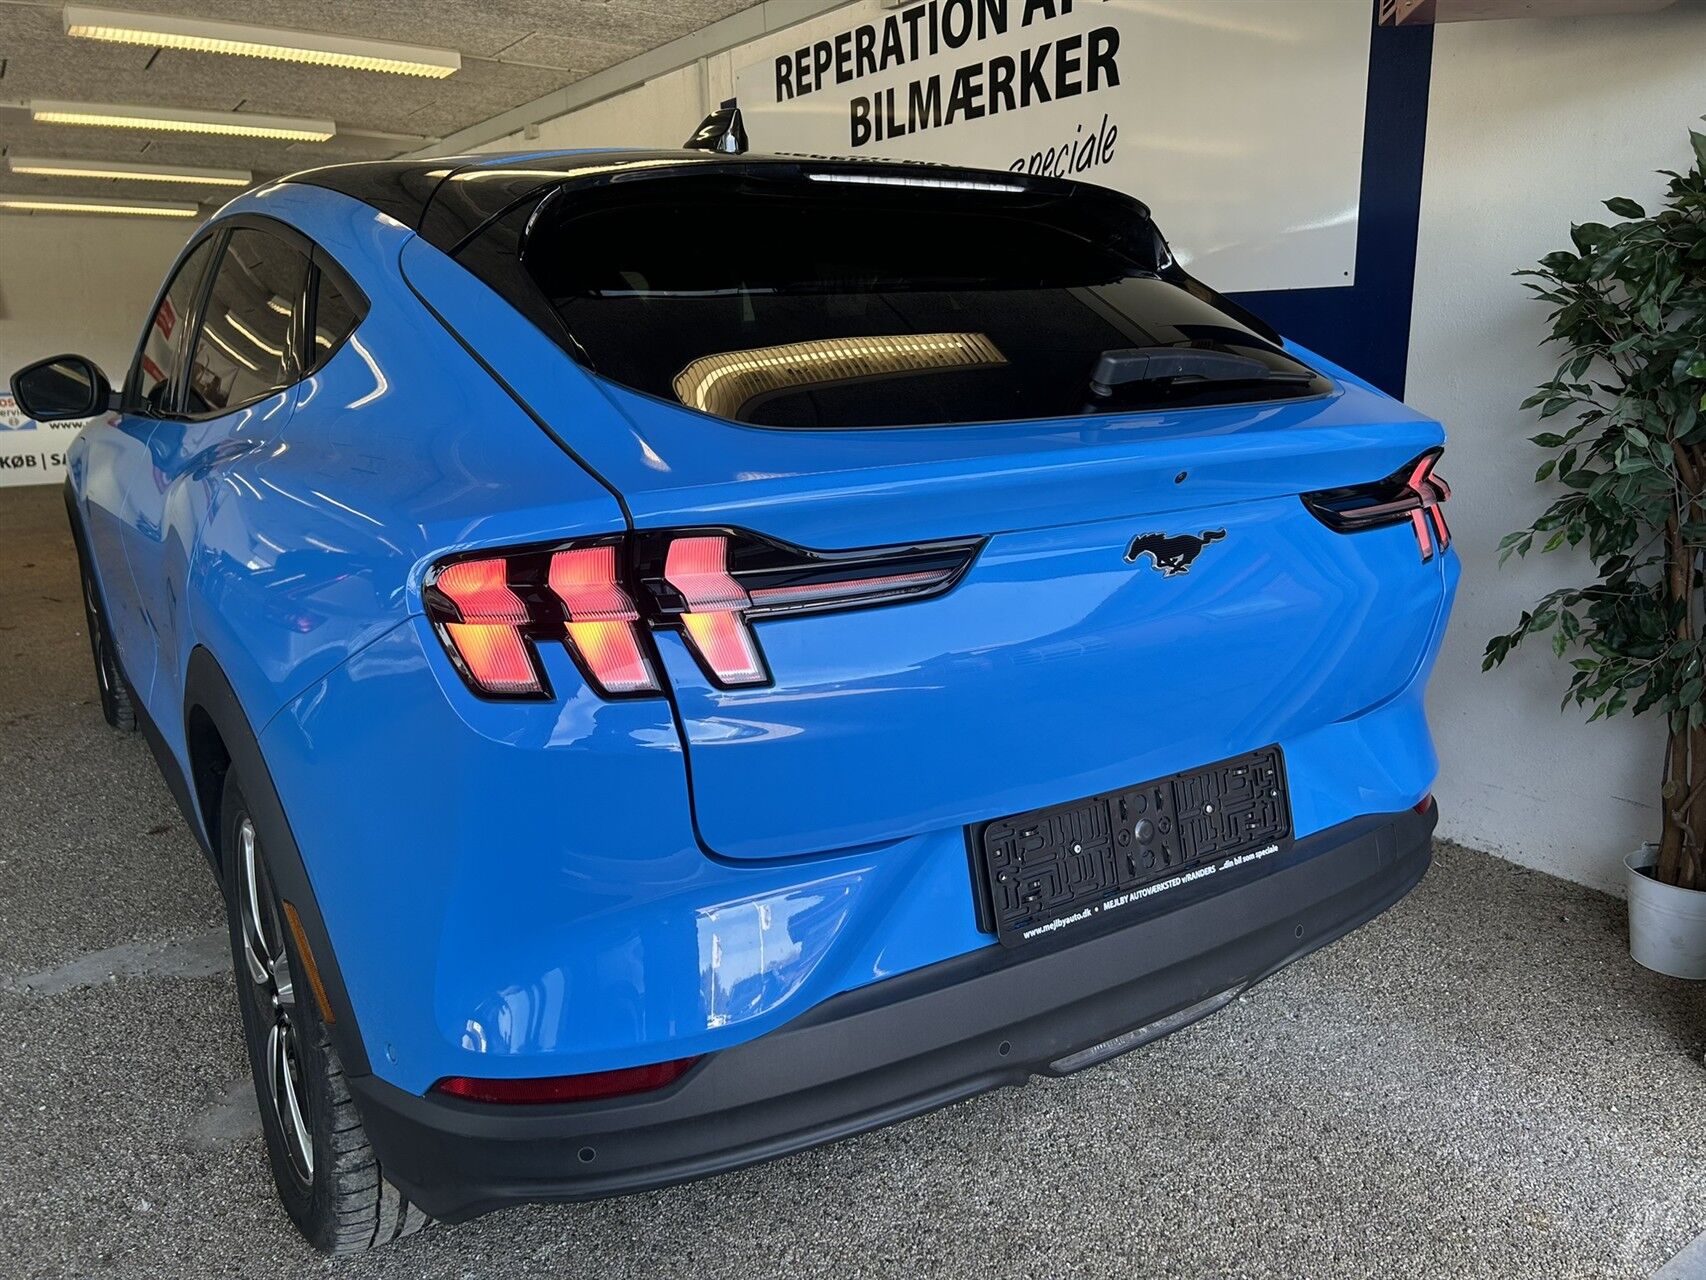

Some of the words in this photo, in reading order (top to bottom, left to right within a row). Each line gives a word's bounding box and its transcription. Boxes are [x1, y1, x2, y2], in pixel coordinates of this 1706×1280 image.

[775, 0, 1008, 103] REPERATION
[850, 26, 1121, 148] BILMÆRKER
[1023, 908, 1092, 939] www.mejlbyauto.dk
[1103, 894, 1129, 911] MEJLBY
[1129, 877, 1182, 902] AUTOVÆRKSTED
[1242, 853, 1255, 863] som
[1255, 844, 1279, 860] speciale
